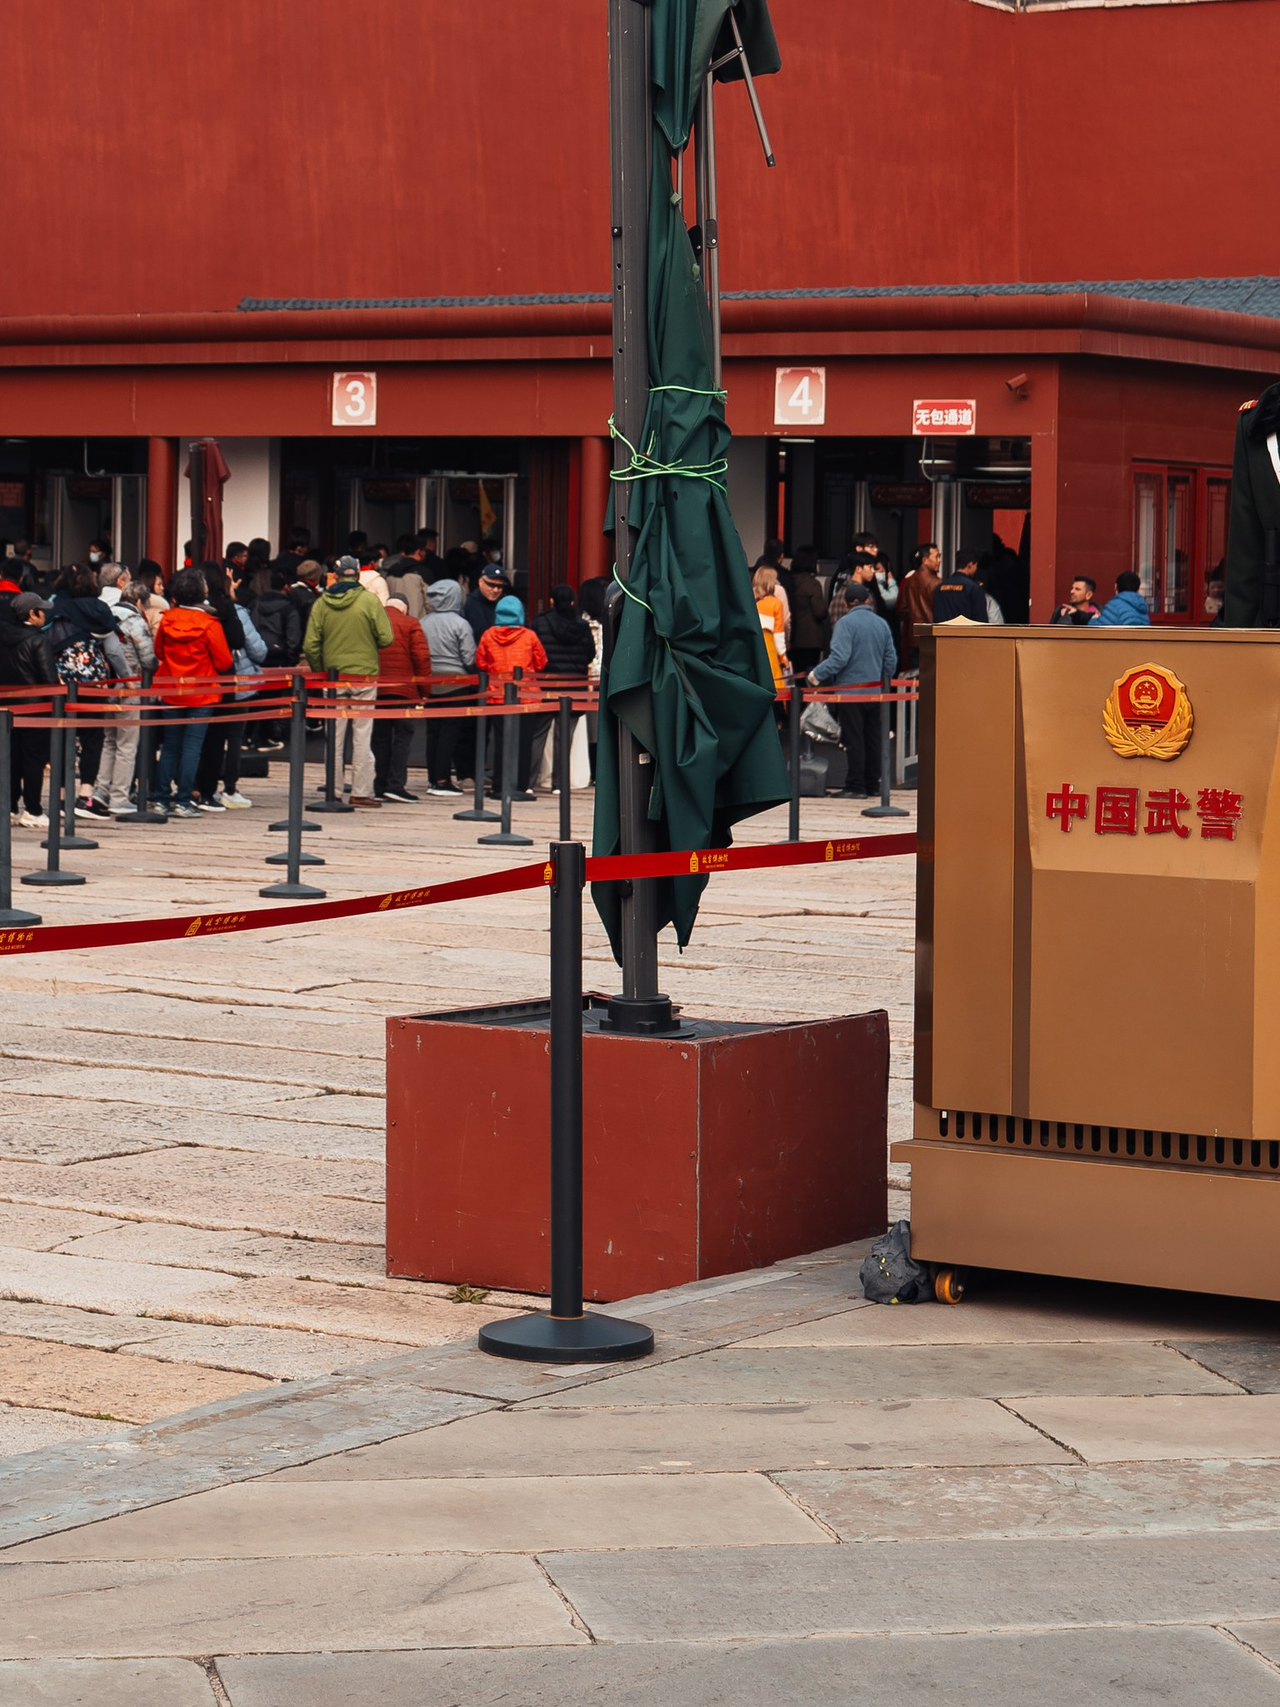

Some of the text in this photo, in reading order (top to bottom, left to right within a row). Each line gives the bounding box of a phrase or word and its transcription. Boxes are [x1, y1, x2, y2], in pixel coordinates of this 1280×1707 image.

[345, 380, 366, 417] 3
[788, 376, 813, 415] 4
[915, 408, 972, 426] 无包通道
[1046, 783, 1243, 840] 中国武警
